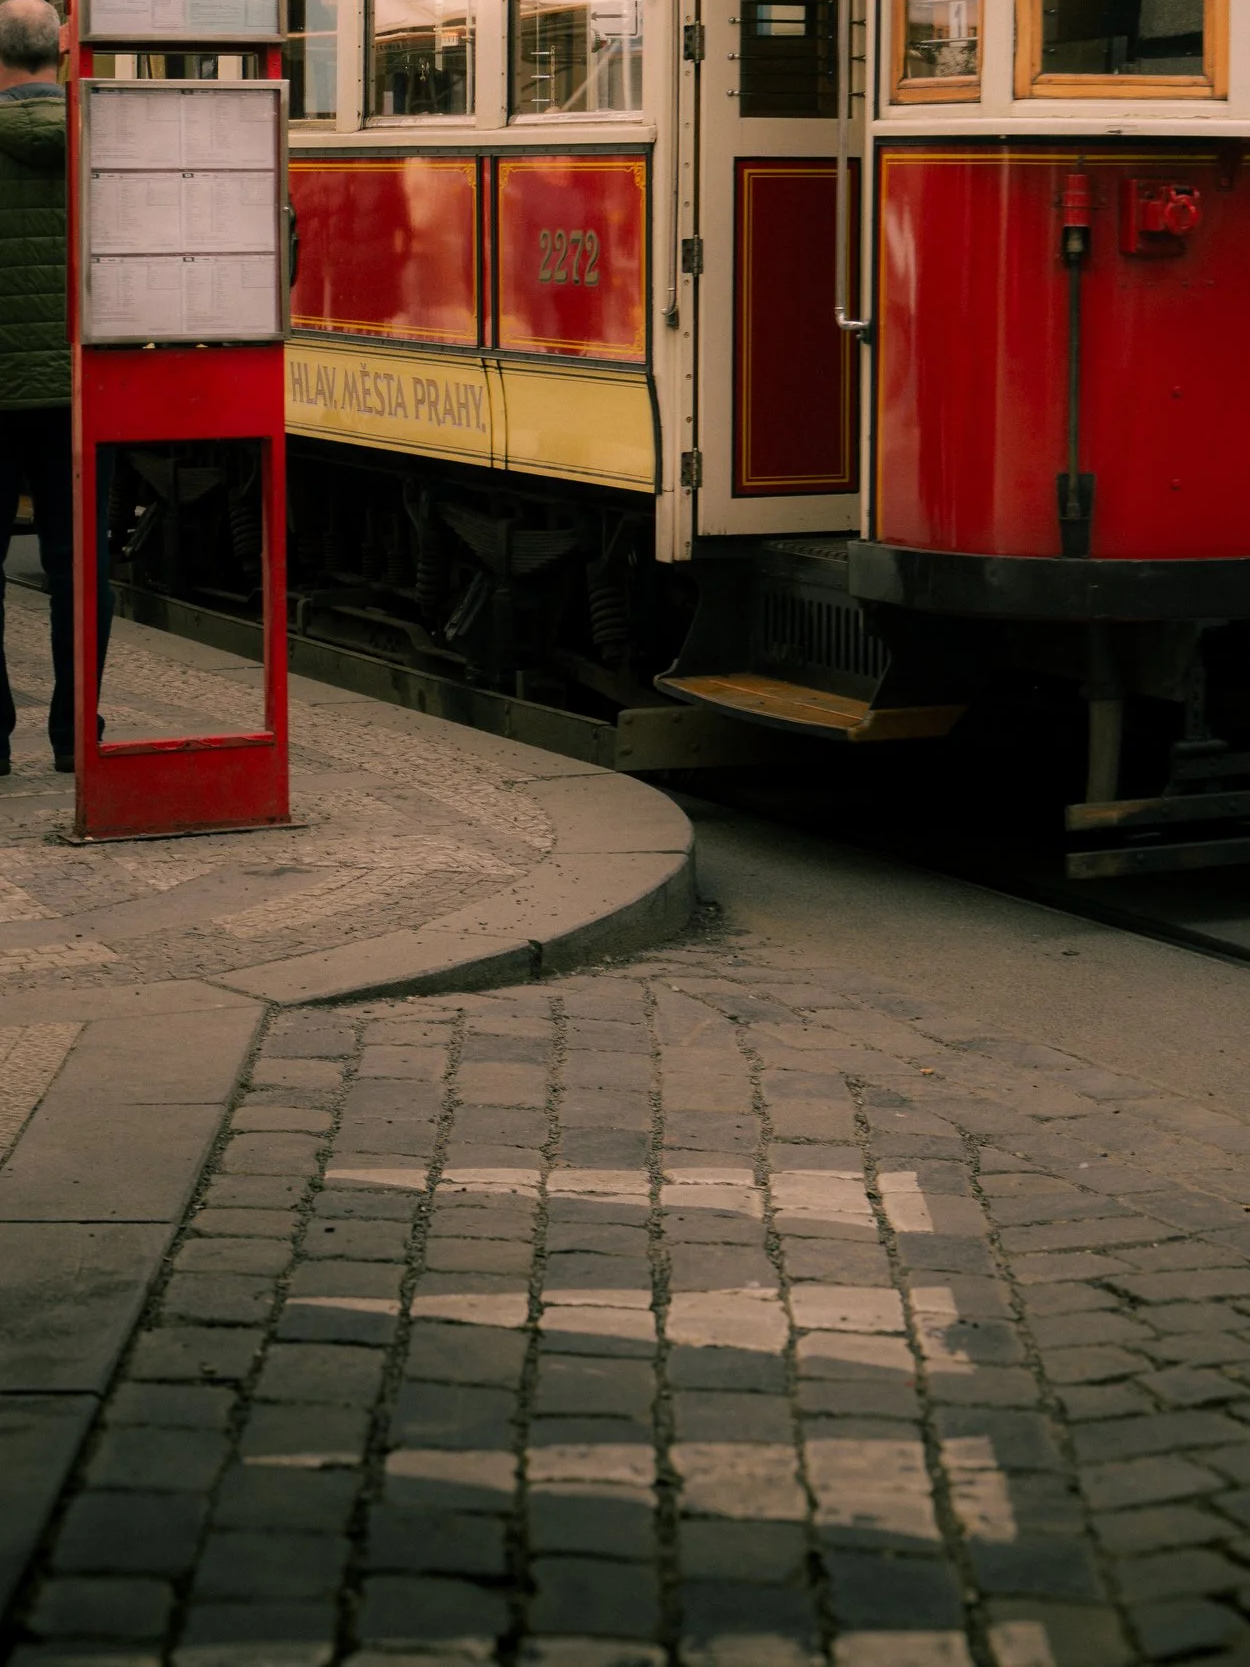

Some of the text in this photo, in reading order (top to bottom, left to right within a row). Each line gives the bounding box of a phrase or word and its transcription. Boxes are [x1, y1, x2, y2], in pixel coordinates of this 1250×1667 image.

[538, 228, 600, 287] 2272
[290, 361, 487, 433] HLAV. MĚSTA PRAHY.
